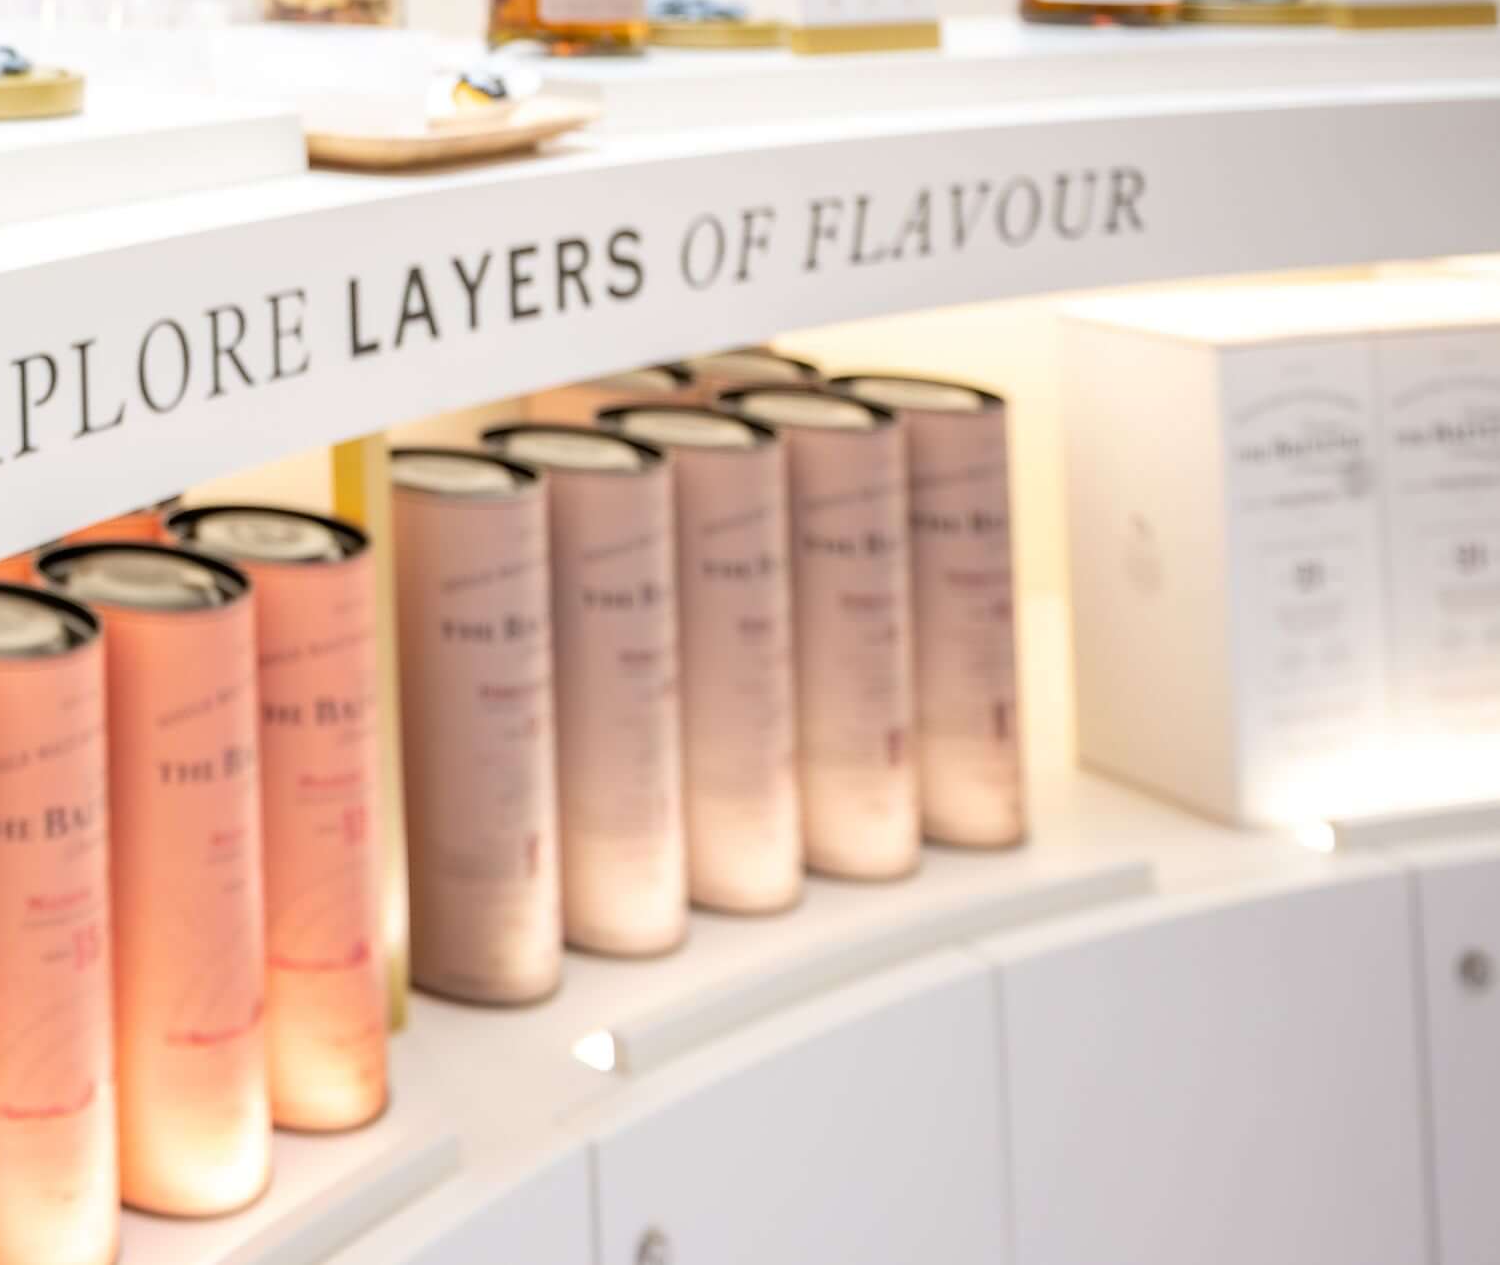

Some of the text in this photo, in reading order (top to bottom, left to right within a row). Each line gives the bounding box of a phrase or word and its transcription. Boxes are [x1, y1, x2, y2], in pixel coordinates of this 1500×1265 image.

[347, 228, 647, 359] LAYERS
[678, 208, 775, 292] OF
[803, 166, 1149, 274] FLAVOUR
